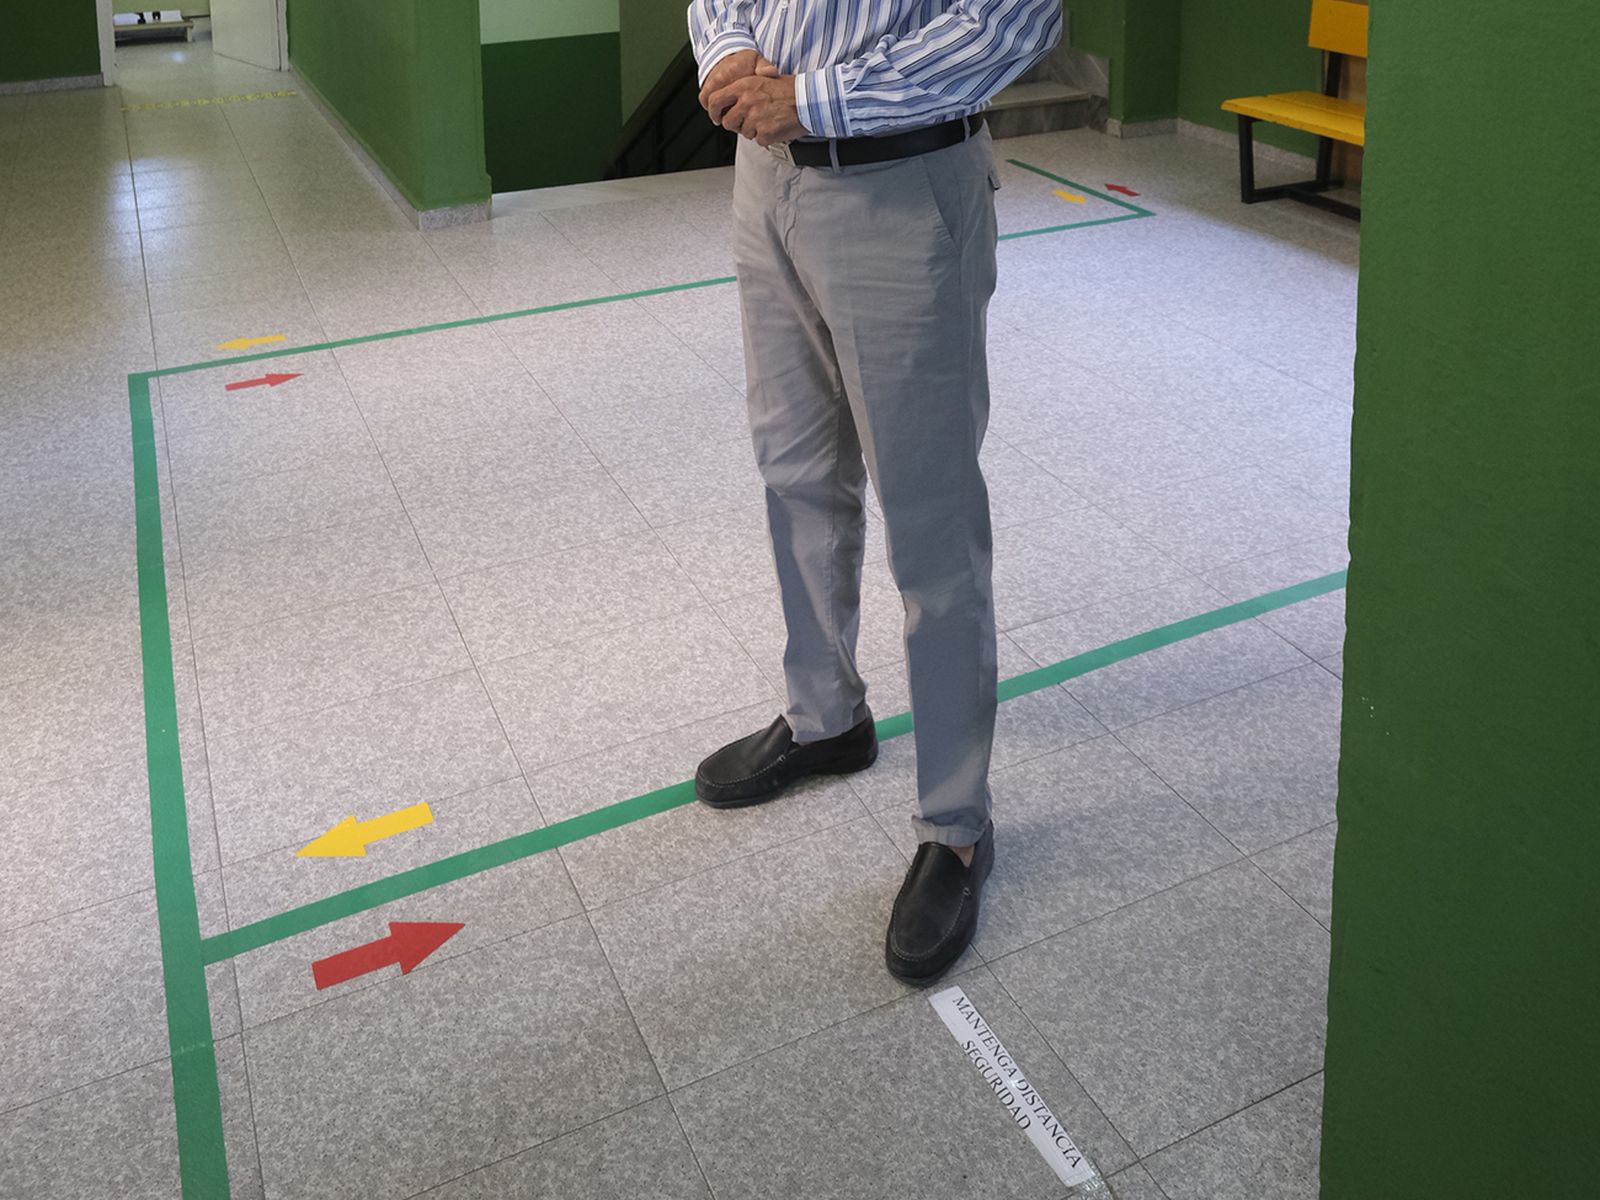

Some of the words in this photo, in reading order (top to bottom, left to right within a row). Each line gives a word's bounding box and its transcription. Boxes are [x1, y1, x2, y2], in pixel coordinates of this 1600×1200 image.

[953, 996, 1018, 1078] MANTENGA
[1016, 1079, 1081, 1168] DISTANCIA
[963, 1040, 1031, 1130] SEGURIDAD
